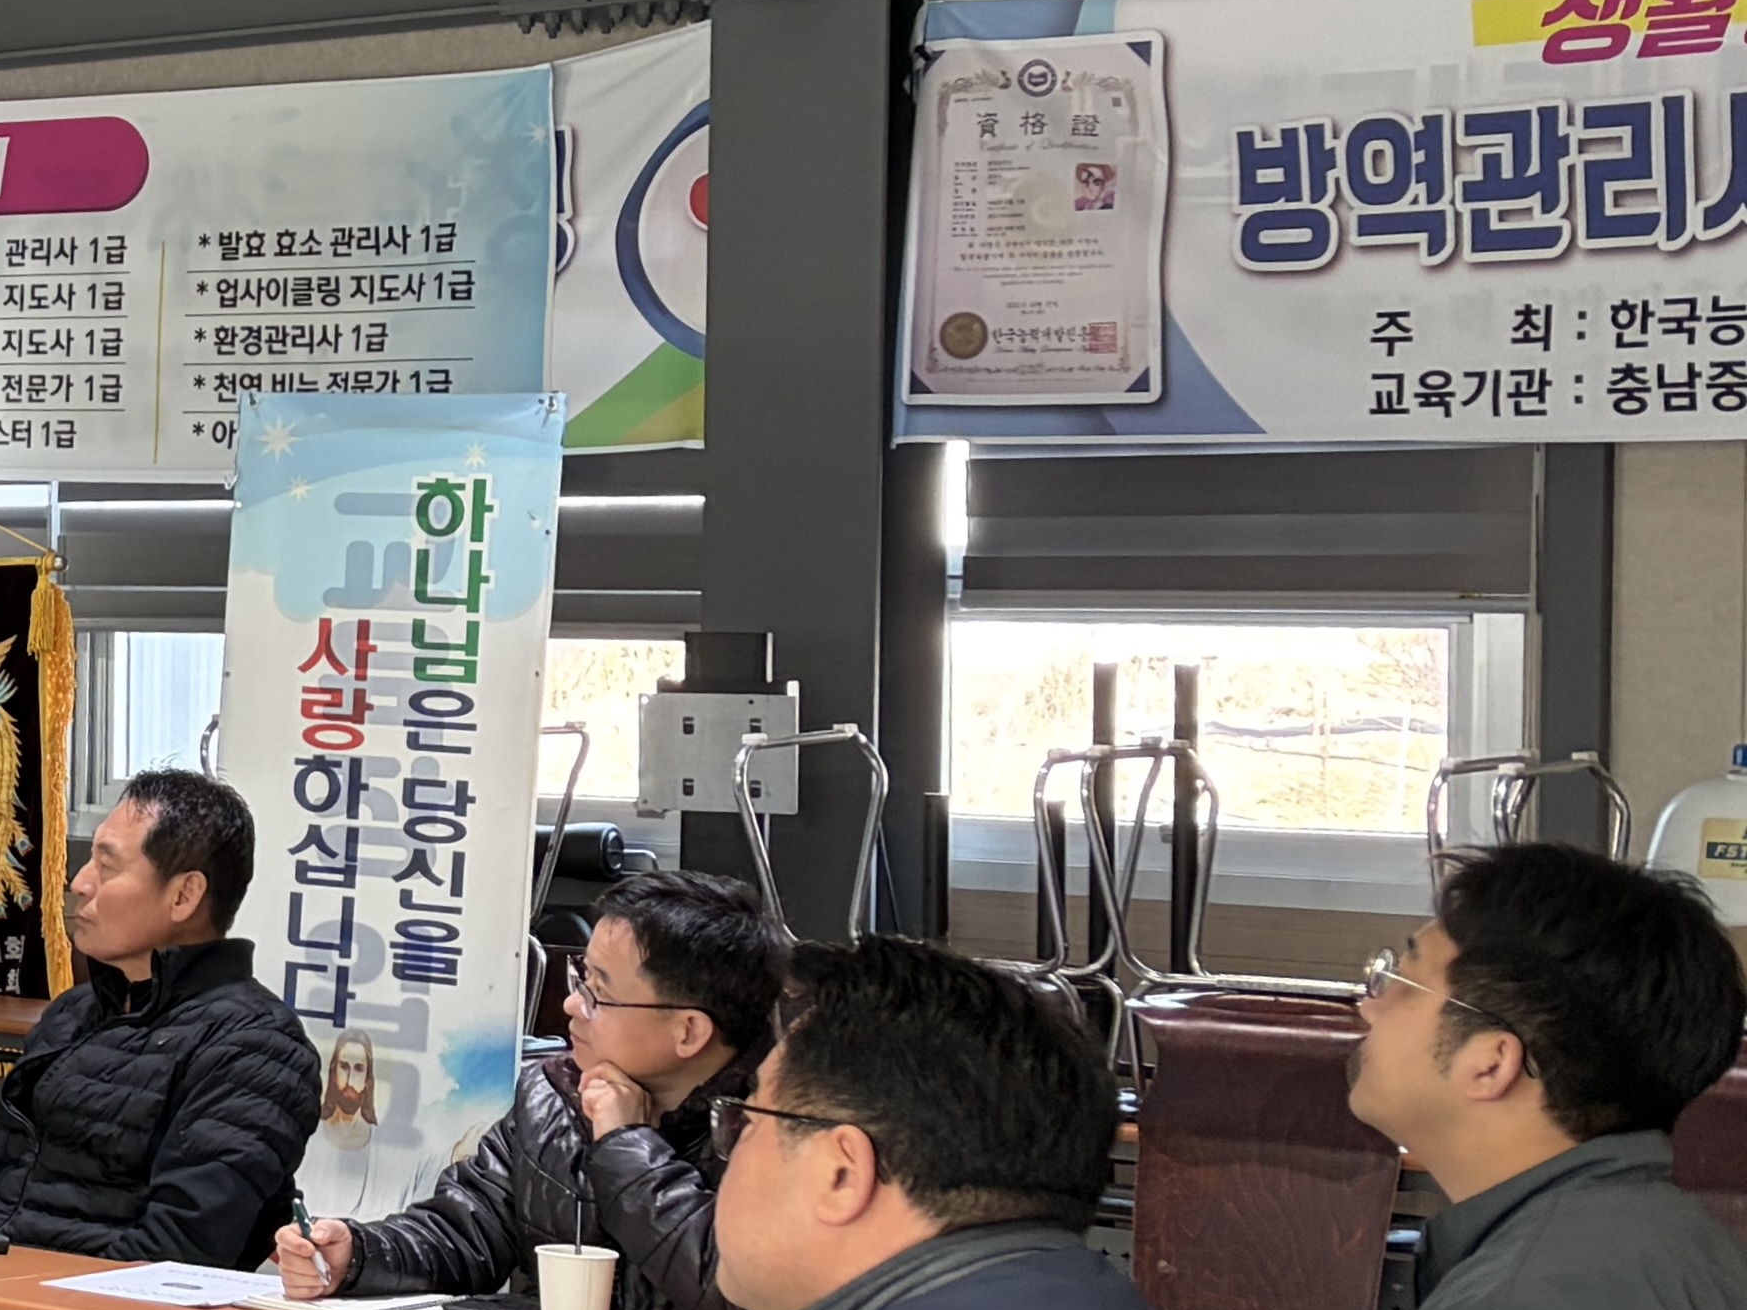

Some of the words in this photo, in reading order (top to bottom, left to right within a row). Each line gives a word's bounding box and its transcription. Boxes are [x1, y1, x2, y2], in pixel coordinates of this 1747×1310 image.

[1237, 100, 1747, 264] 방역관리
[5, 237, 78, 267] 관리사
[87, 235, 128, 265] 1급
[217, 228, 268, 262] 발효
[273, 227, 325, 260] 효소
[331, 224, 411, 257] 관리사
[419, 222, 458, 254] 1급
[2, 282, 77, 312] 지도사
[86, 281, 126, 311] 1급
[216, 274, 342, 309] 업사이클링
[350, 273, 426, 306] 지도사
[433, 269, 476, 302] 1급
[1, 328, 75, 358] 지도사
[84, 327, 125, 357] 1급
[213, 324, 343, 357] 환경관리사
[350, 321, 389, 353] 1급
[1370, 310, 1413, 357] 주
[1510, 303, 1553, 352] 최
[1, 373, 74, 403] 전문가
[84, 374, 123, 403] 1급
[1368, 368, 1553, 419] 교육기관
[41, 419, 77, 449] 1급
[403, 478, 495, 755] 하나님은
[283, 618, 378, 1029] 사랑하십니다
[389, 778, 476, 987] 당신을
